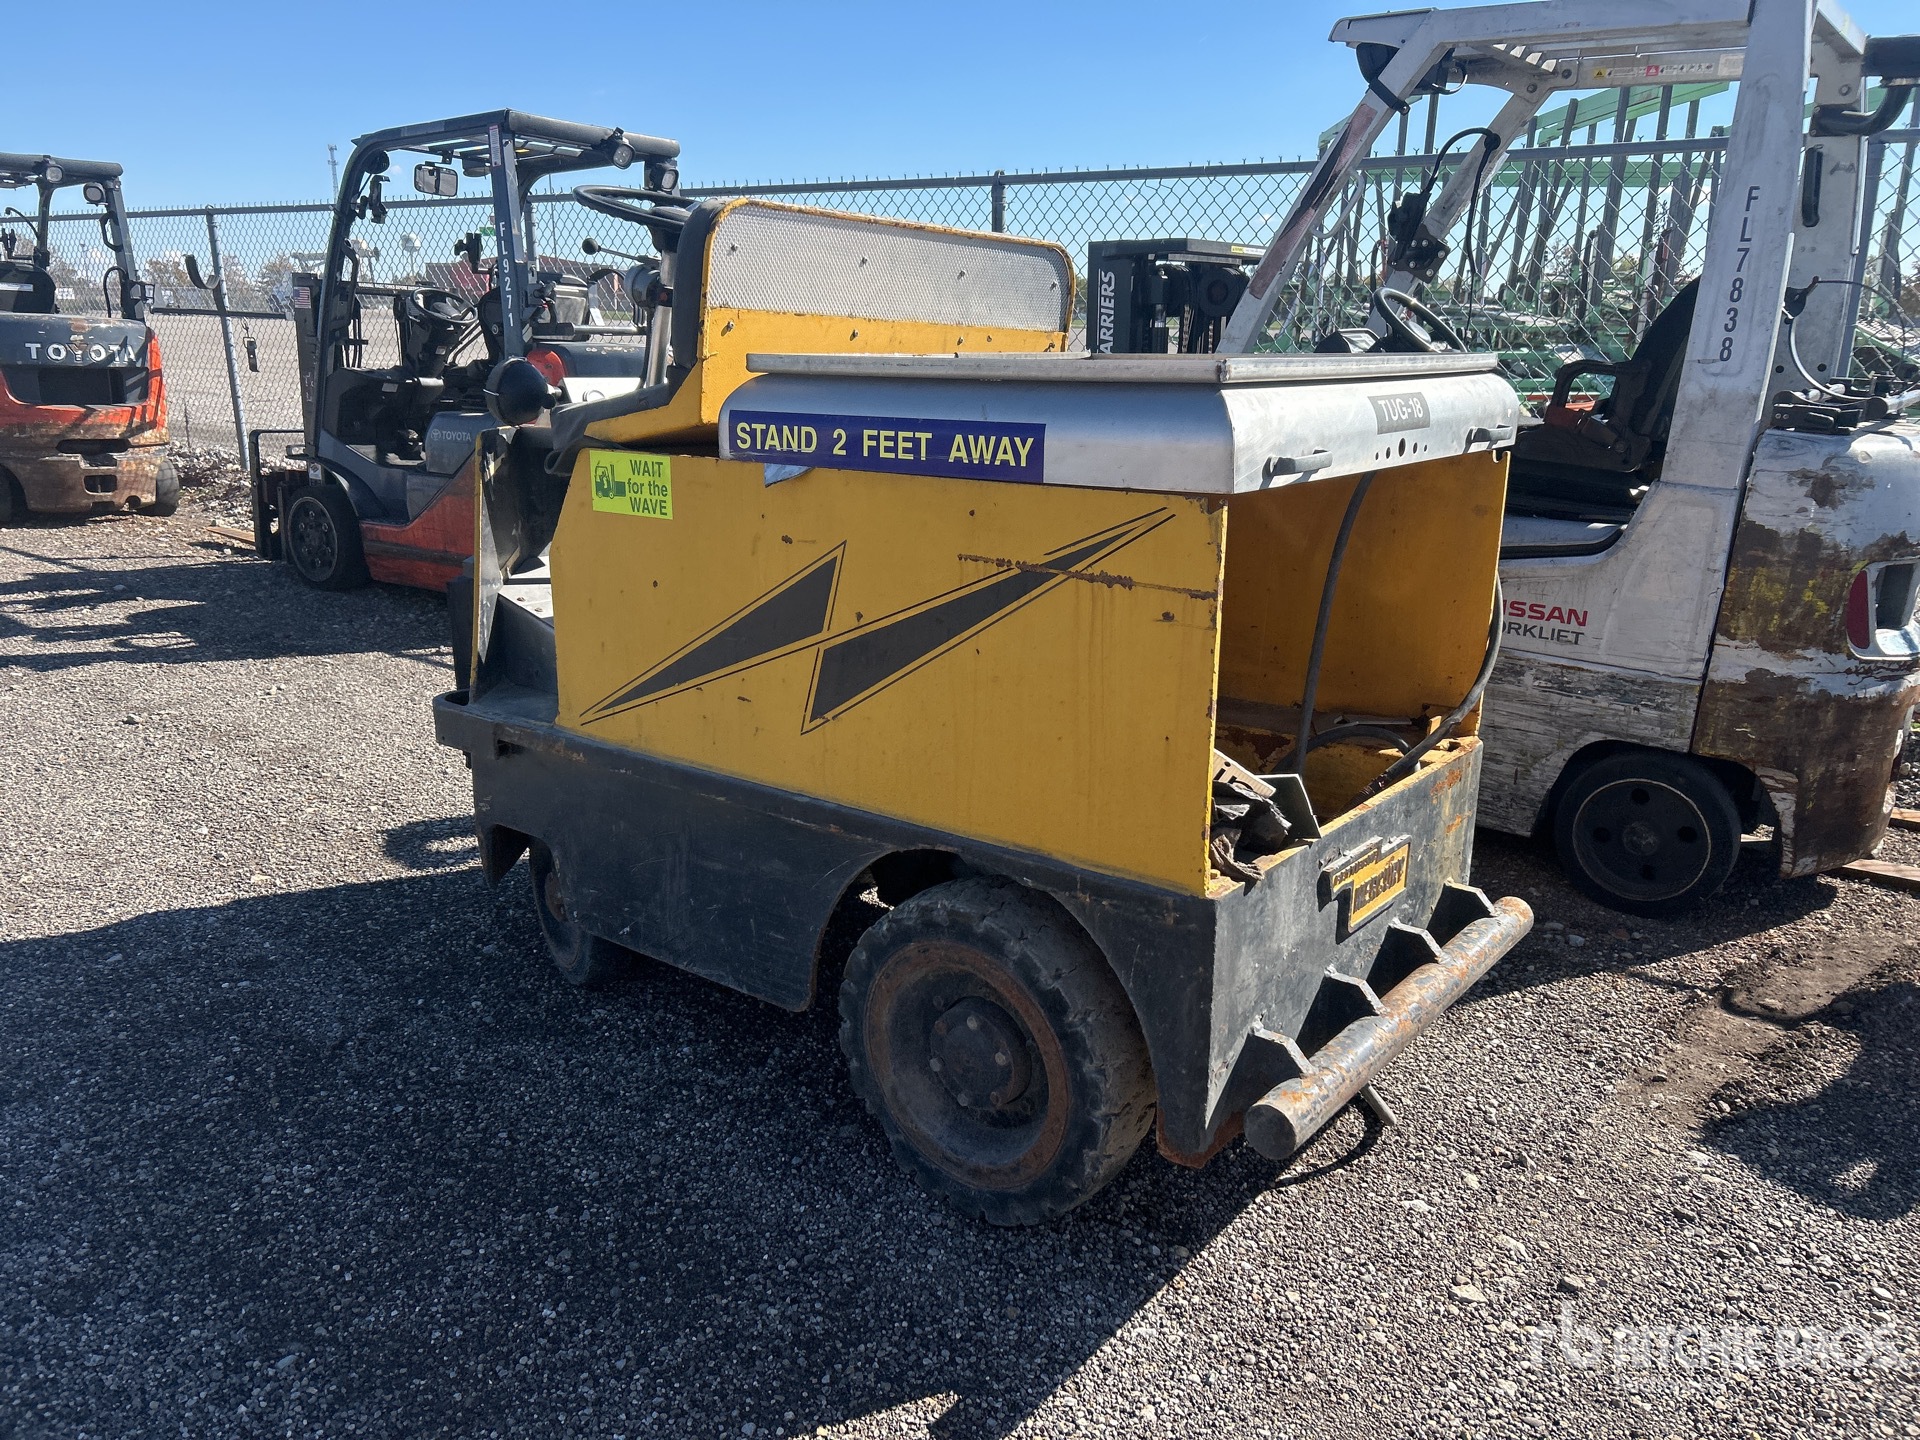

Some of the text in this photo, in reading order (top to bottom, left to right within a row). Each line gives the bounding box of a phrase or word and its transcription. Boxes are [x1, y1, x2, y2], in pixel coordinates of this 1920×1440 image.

[499, 221, 514, 327] FL9271
[1719, 185, 1761, 361] FL7838
[1100, 270, 1116, 354] ARRIERS
[25, 342, 138, 363] TOYOTA
[1377, 397, 1424, 421] TUG-18
[442, 430, 472, 441] TOYOTA
[736, 422, 1034, 467] STAND 2 FEET AWAY
[629, 459, 663, 478] WAIT
[627, 477, 668, 497] for the
[629, 496, 668, 516] WAVE
[1502, 600, 1588, 627] ISSAN
